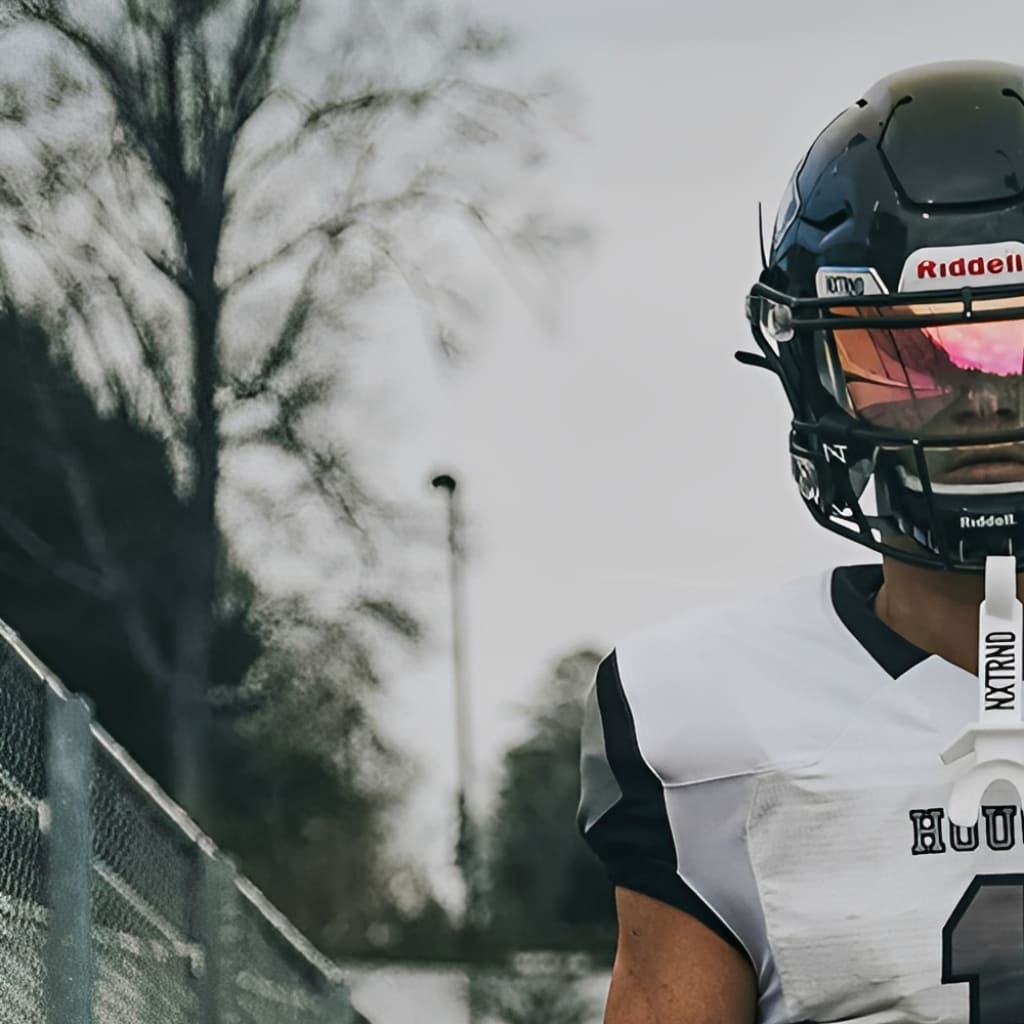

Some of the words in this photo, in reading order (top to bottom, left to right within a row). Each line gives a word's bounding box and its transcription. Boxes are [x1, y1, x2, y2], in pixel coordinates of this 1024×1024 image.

[917, 254, 1023, 279] Riddell
[960, 513, 1018, 529] Riddell
[984, 631, 1016, 711] NXTRND
